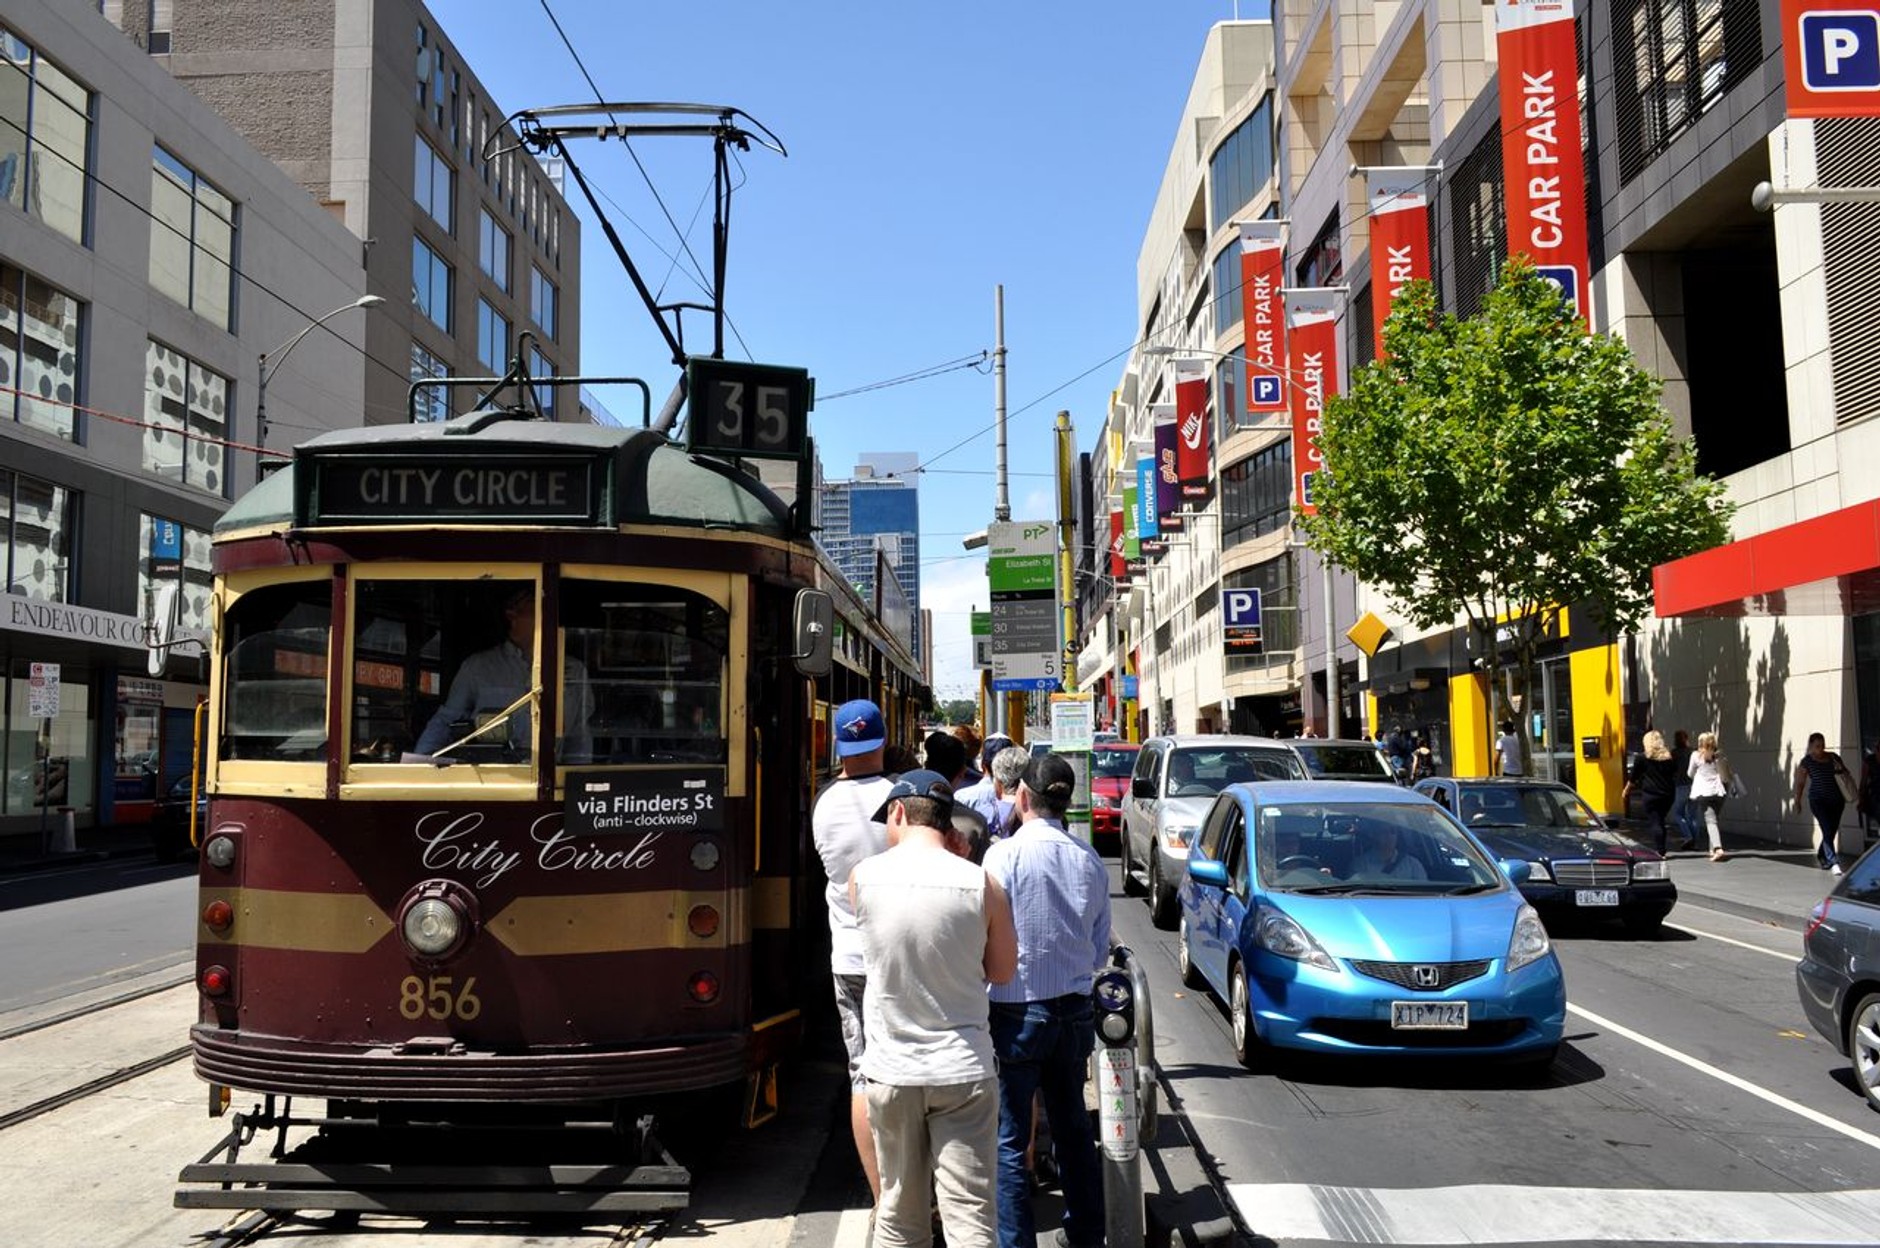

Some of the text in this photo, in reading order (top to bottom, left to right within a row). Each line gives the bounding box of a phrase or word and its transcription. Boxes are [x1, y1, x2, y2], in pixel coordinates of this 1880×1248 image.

[1823, 28, 1859, 74] P
[1522, 70, 1563, 248] CAR PARK
[1386, 245, 1412, 298] ARK
[1254, 274, 1274, 367] CAR PARK
[1260, 381, 1273, 398] P
[1303, 352, 1323, 413] PARK
[717, 381, 789, 445] 35
[359, 468, 567, 505] CITY CIRCLE
[1144, 470, 1155, 523] CONVERSE
[11, 601, 117, 640] ENDEAVOUR
[993, 606, 1006, 616] 24
[994, 623, 1008, 633] 30
[1229, 593, 1252, 622] P
[994, 640, 1009, 651] 35
[1045, 661, 1055, 675] 5
[577, 793, 713, 814] via Flinders St
[415, 811, 663, 889] City Circle
[400, 975, 482, 1020] 856
